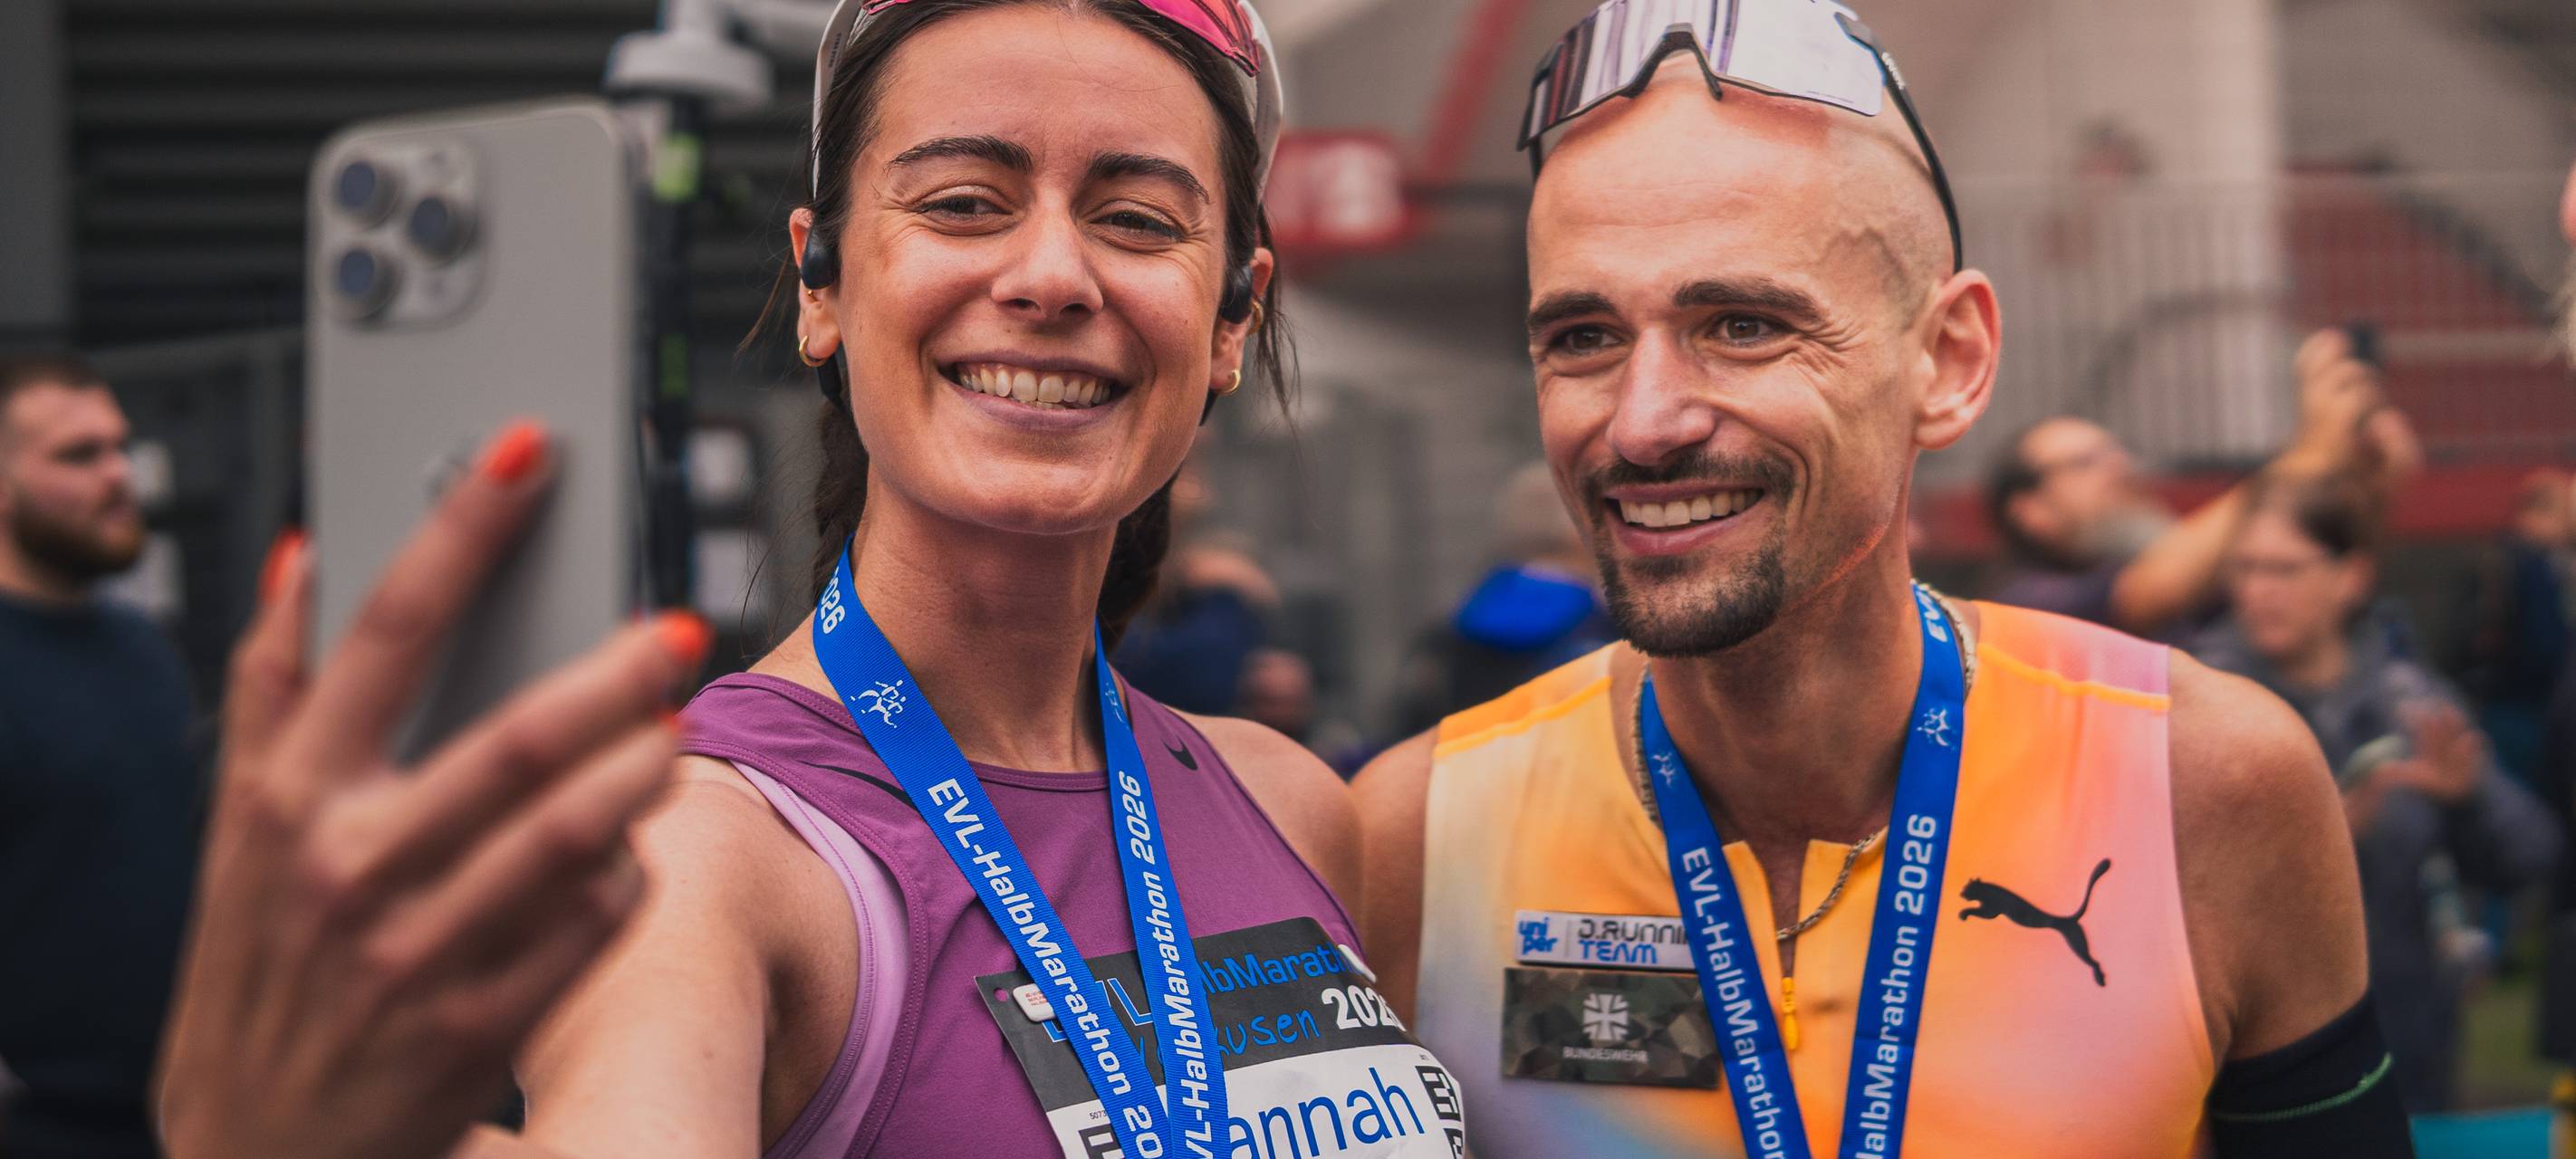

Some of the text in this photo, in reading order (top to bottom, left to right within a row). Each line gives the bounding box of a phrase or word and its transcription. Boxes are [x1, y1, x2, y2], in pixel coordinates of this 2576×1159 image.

[821, 566, 846, 634] 026
[1120, 770, 1156, 866] 2026
[1894, 814, 1937, 915] 2026
[928, 778, 1131, 1097] EVL-HalbMarathon
[1578, 940, 1658, 964] TEAM
[1562, 1046, 1648, 1065] BUNDESWEHR
[1228, 1067, 1426, 1159] annah
